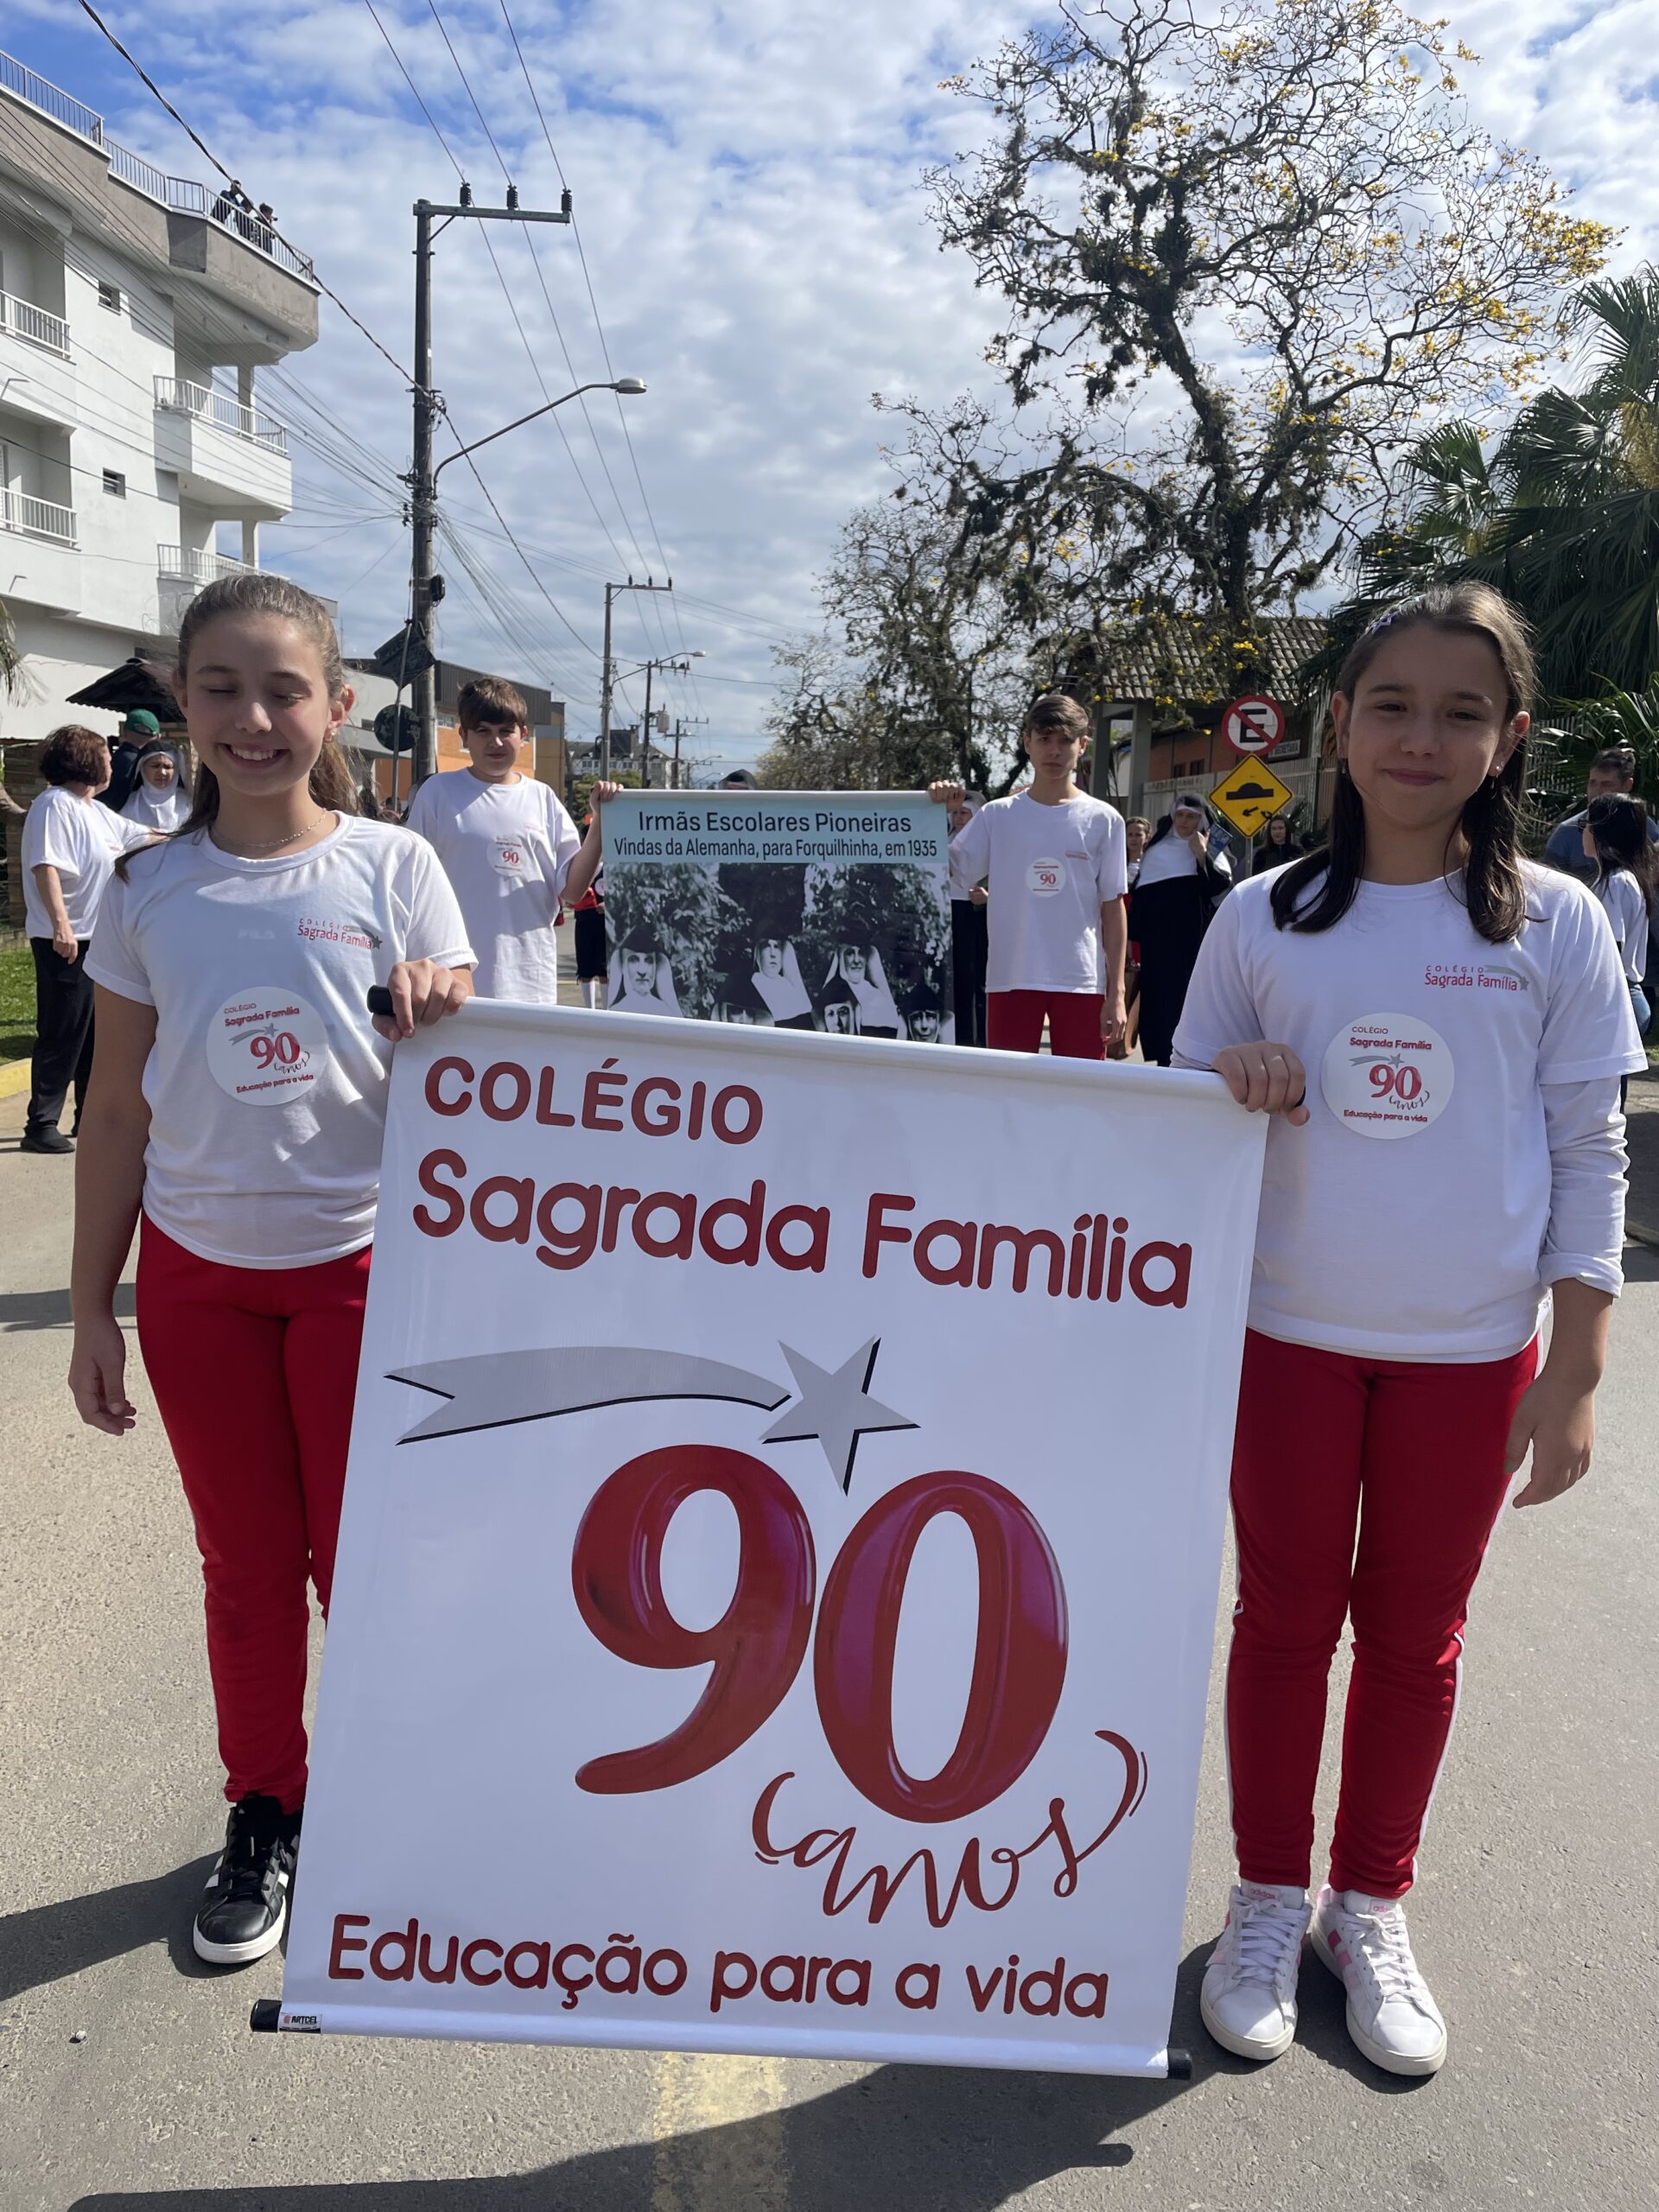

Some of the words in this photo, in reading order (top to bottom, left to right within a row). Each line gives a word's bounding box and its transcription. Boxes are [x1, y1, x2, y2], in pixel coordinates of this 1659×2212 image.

[1240, 709, 1267, 743] E
[639, 810, 701, 832] Irmãs
[707, 811, 810, 832] Escolares
[816, 812, 912, 832] Pioneiras
[502, 851, 519, 864] 90
[614, 837, 663, 856] Vindas
[665, 838, 683, 856] da
[686, 838, 760, 860] Alemanha,
[762, 843, 793, 860] para
[796, 839, 882, 861] Forquilhinha,
[885, 844, 906, 856] em
[908, 840, 938, 857] 1935
[1039, 874, 1057, 885] 90
[297, 925, 339, 941] Sagrada
[1426, 964, 1484, 974] COLÉGIO
[1424, 972, 1473, 988] Sagrada
[1478, 974, 1517, 991] Família
[225, 1013, 264, 1027] Sagrada
[250, 1032, 301, 1070] 90
[1350, 1037, 1394, 1049] Sagrada
[1395, 1039, 1433, 1051] Família
[273, 1077, 292, 1088] para
[298, 1073, 315, 1082] vida
[1369, 1064, 1422, 1101] 90
[426, 1057, 762, 1144] COLÉGIO
[1344, 1109, 1383, 1120] Educação
[1383, 1113, 1403, 1122] para
[1411, 1114, 1428, 1122] vida
[414, 1149, 830, 1272] Sagrada
[862, 1193, 1192, 1308] Família
[573, 1443, 1068, 1823] 90
[329, 1915, 687, 2009] Educação
[711, 1948, 871, 2012] para
[895, 1962, 940, 2009] a
[967, 1955, 1108, 2018] vida
